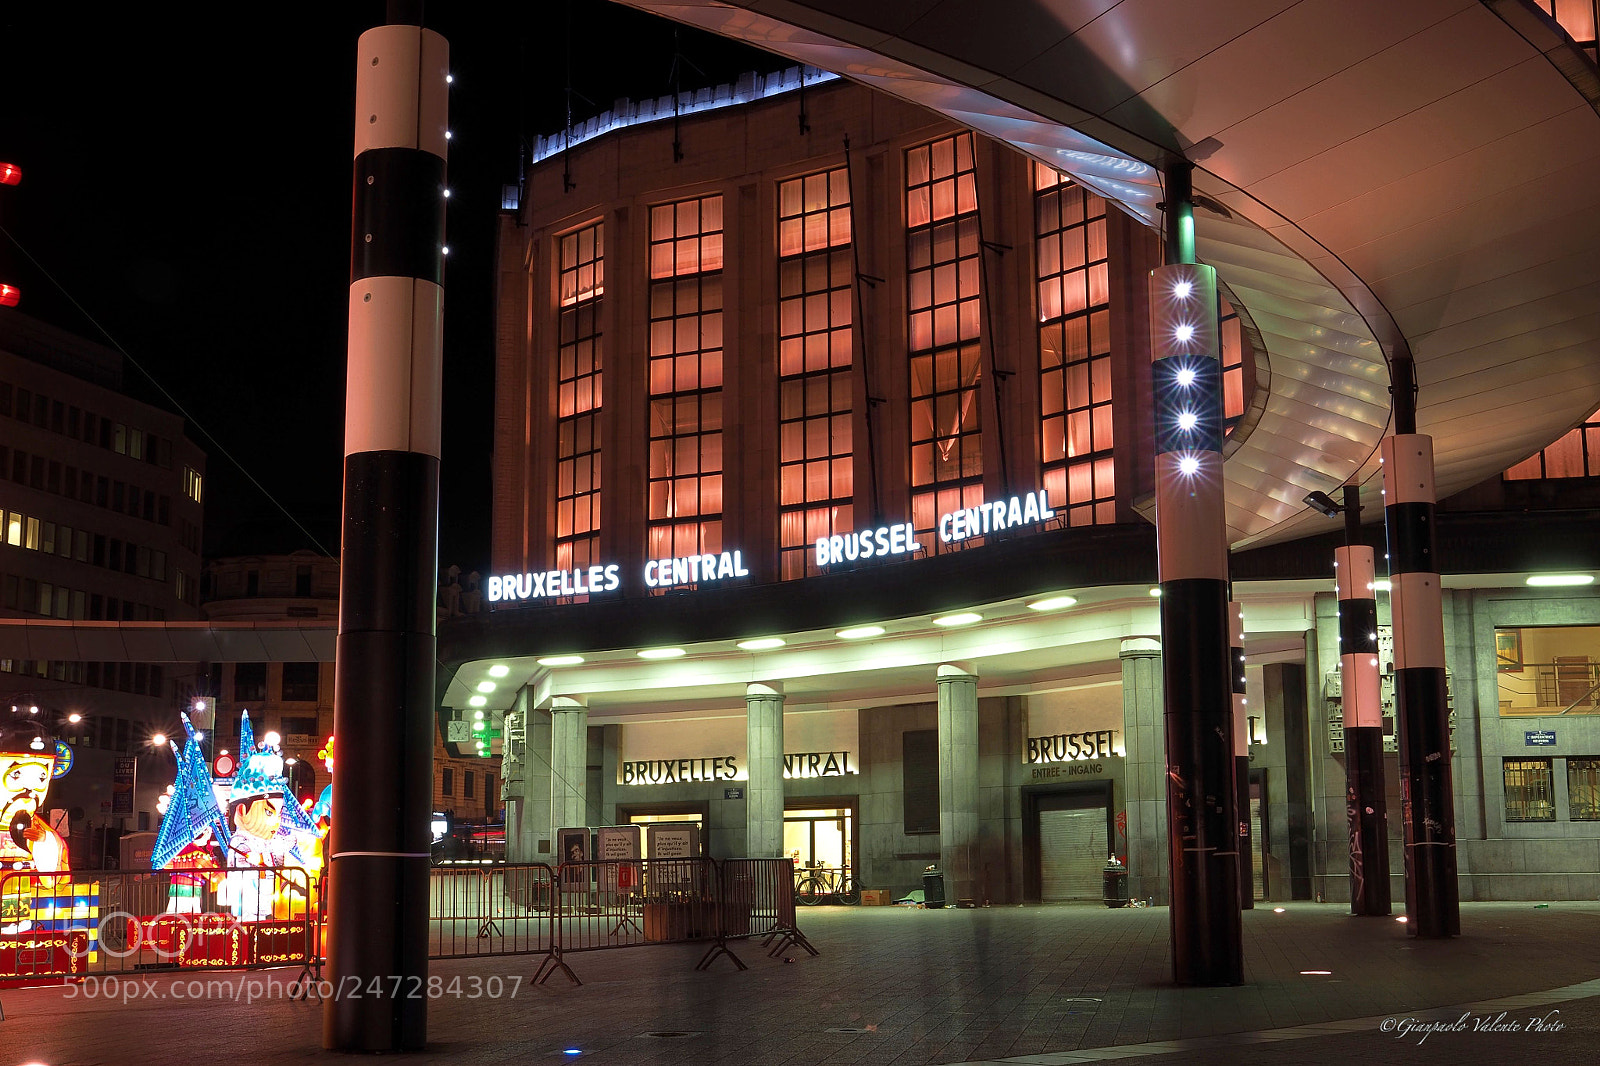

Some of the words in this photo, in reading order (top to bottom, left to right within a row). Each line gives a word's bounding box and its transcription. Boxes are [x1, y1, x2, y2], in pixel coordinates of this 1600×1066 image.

[816, 522, 920, 566] BRUSSEL
[939, 489, 1054, 543] CENTRAAL
[488, 564, 620, 602] BRUXELLES
[644, 550, 749, 588] CENTRAL
[1028, 730, 1118, 763] BRUSSEL
[623, 756, 738, 784] BRUXELLES
[784, 751, 854, 777] NTRAL
[1068, 763, 1103, 776] INGANG
